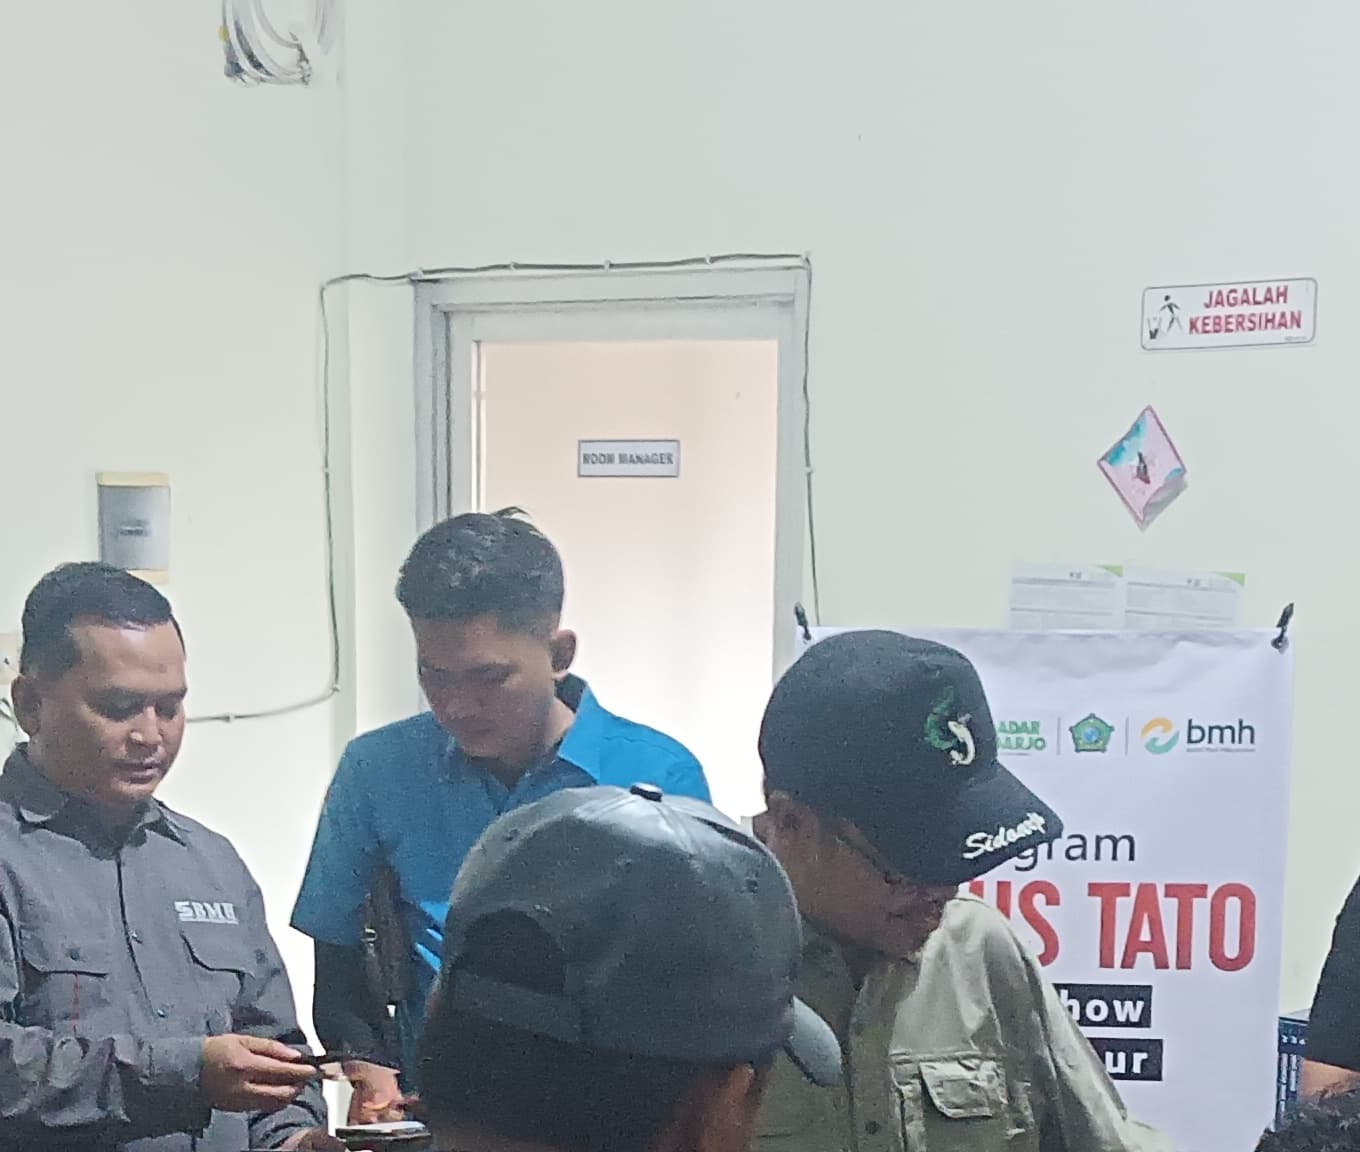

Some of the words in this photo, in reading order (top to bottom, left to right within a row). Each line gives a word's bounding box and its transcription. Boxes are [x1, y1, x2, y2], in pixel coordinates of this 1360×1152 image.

[1203, 285, 1289, 309] JAGALAH
[1189, 310, 1303, 335] KEBERSIHAN
[583, 452, 615, 464] ROOM
[618, 452, 674, 464] MANAGER
[997, 720, 1040, 735] ADAR
[1186, 718, 1256, 745] bmh
[1014, 833, 1136, 871] gram
[1087, 882, 1257, 972] TATO
[1060, 989, 1144, 1023] how
[1105, 1050, 1148, 1074] ur
